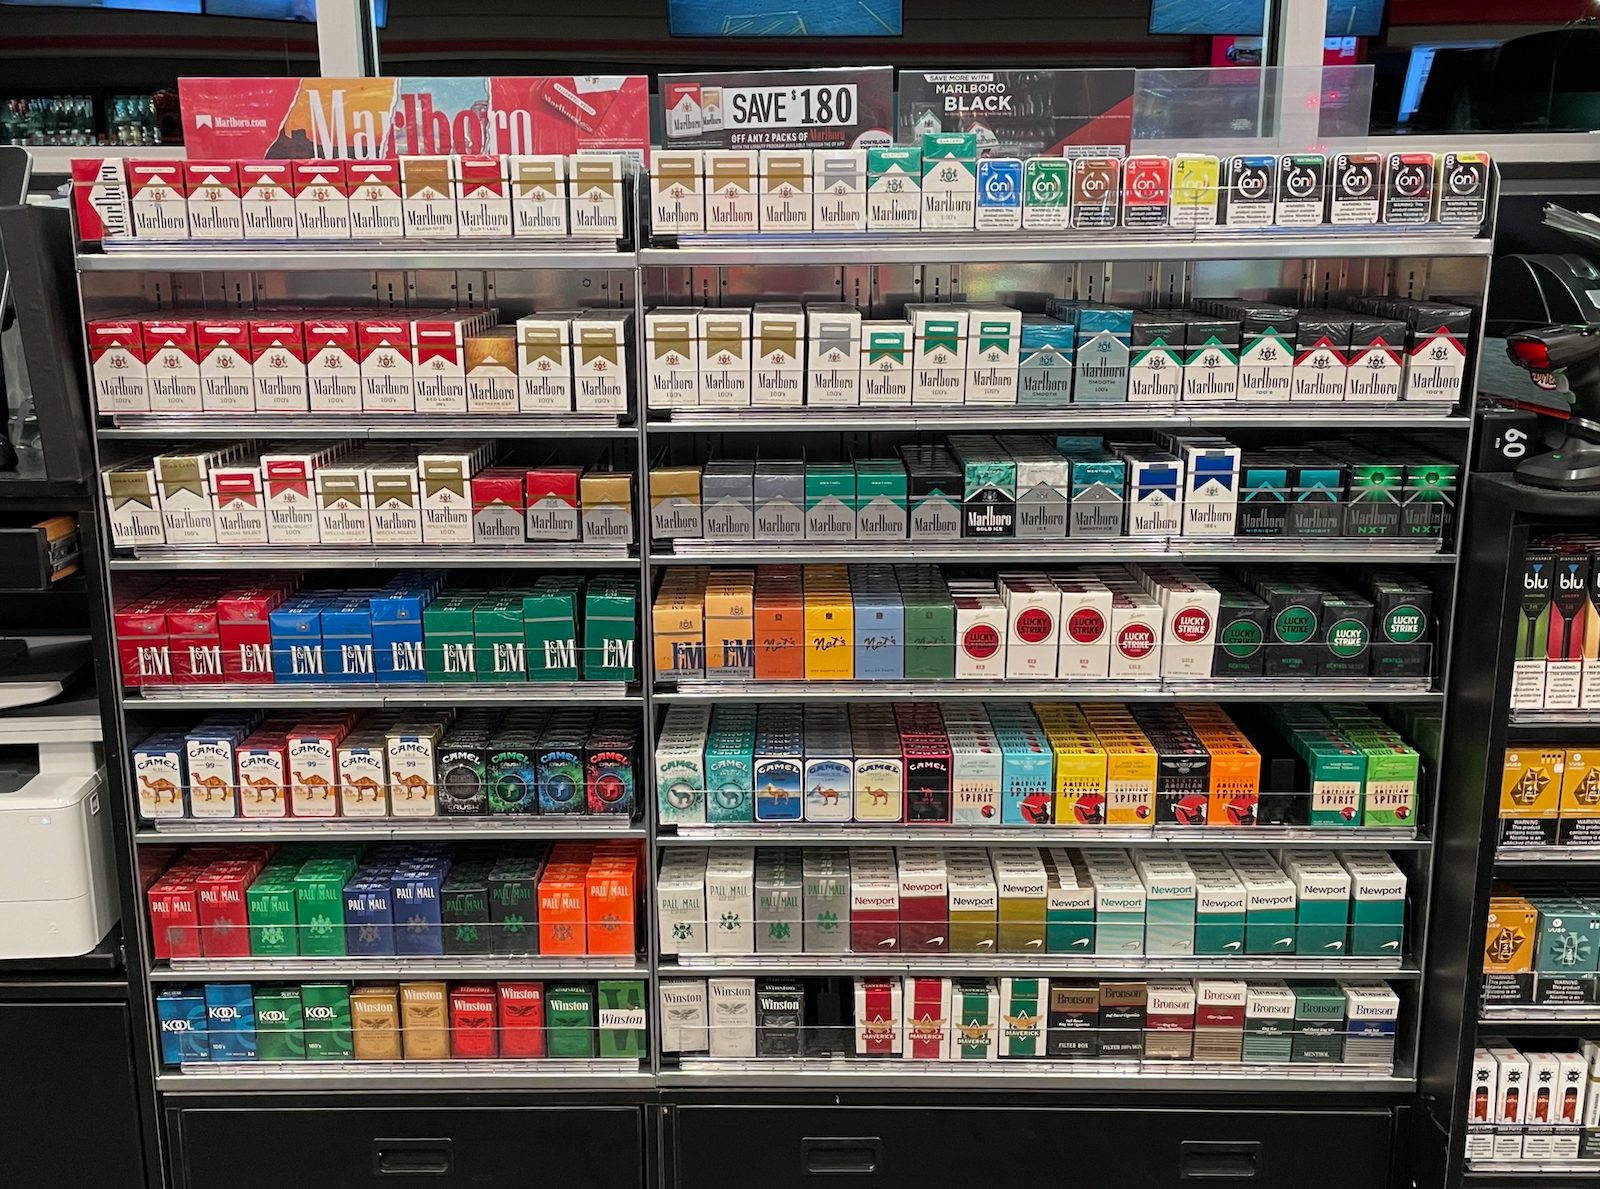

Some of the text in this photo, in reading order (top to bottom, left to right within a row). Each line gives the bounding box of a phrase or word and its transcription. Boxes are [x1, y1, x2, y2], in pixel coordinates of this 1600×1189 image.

[930, 73, 990, 82] SAVE MORE WITH
[935, 83, 1005, 94] MARLBORO
[732, 92, 787, 124] SAVE
[945, 95, 1012, 112] BLACK
[214, 116, 267, 129] Marlboro.com
[306, 89, 532, 159] Marlboro
[732, 128, 846, 144] OFF ANY 2 PACKS OF Marlboro
[980, 162, 989, 172] 4
[1234, 158, 1242, 170] 8
[1282, 157, 1292, 168] 8
[94, 166, 125, 237] Marlboro
[462, 204, 508, 226] Marlboro
[658, 202, 699, 222] Marlboro
[766, 202, 807, 222] Marlboro
[872, 200, 918, 221] Marlboro
[138, 207, 184, 229] Marlboro
[246, 206, 293, 228] Marlboro
[353, 206, 400, 228] Marlboro
[814, 369, 854, 390] Marlboro
[920, 368, 960, 386] Marlboro
[973, 368, 1012, 386] Marlboro
[100, 376, 143, 396] Marlboro
[206, 376, 250, 396] Marlboro
[417, 376, 464, 398] Marlboro
[525, 376, 566, 396] Marlboro
[1132, 374, 1178, 395] Marlboro
[1350, 374, 1398, 394] Marlboro
[1502, 428, 1528, 458] 09
[166, 508, 212, 529] Marlboro
[271, 506, 313, 524] Marlboro
[426, 505, 468, 523] Marlboro
[1020, 506, 1064, 527] Marlboro
[1190, 503, 1232, 522] Marlboro
[114, 512, 160, 538] Marlboro
[530, 512, 573, 530] Marlboro
[655, 510, 698, 530] Marlboro
[860, 514, 903, 533] Marlboro
[1358, 526, 1388, 534] NXT
[1412, 526, 1440, 534] NXT
[1024, 618, 1046, 626] LUCKY
[1180, 618, 1206, 626] LUCKY
[1392, 615, 1419, 625] LUCKY
[1021, 625, 1047, 634] STRIKE
[1178, 624, 1206, 634] STRIKE
[1336, 628, 1362, 638] LUCKY
[1390, 624, 1418, 633] STRIKE
[1124, 632, 1149, 642] LUCKY
[1334, 636, 1361, 647] STRIKE
[1120, 640, 1150, 650] STRIKE
[240, 643, 273, 672] L&M
[392, 642, 424, 672] L&M
[493, 643, 526, 672] L&M
[602, 639, 634, 668] L&M
[722, 639, 754, 668] L&M
[137, 646, 171, 676] L&M
[290, 645, 324, 675] L&M
[290, 744, 331, 758] CAMEL
[390, 744, 431, 758] CAMEL
[240, 757, 281, 770] CAMEL
[442, 750, 481, 765] CAMEL
[590, 750, 628, 765] CAMEL
[137, 758, 178, 772] CAMEL
[306, 760, 316, 768] 99
[406, 760, 416, 768] 99
[660, 759, 698, 773] CAMEL
[758, 762, 800, 774] CAMEL
[910, 761, 947, 772] CAMEL
[1064, 780, 1100, 788] AMERICAN
[960, 794, 994, 802] SPIRIT
[1115, 794, 1148, 802] SPIRIT
[1320, 795, 1356, 804] SPIRIT
[1374, 794, 1408, 804] SPIRIT
[902, 882, 943, 892] Newport
[1152, 884, 1192, 895] Newport
[1304, 884, 1346, 896] Newport
[1360, 886, 1402, 896] Newport
[201, 890, 240, 902] PALL MALL
[854, 895, 895, 906] Newport
[954, 896, 994, 906] Newport
[153, 902, 192, 912] PALL MALL
[349, 899, 387, 911] PALL MALL
[542, 898, 580, 909] PALL MALL
[662, 898, 700, 909] PALL MALL
[1052, 898, 1090, 908] Newport
[664, 992, 702, 1003] Winston
[1057, 994, 1094, 1004] Bronson
[1204, 988, 1240, 1000] Bronson
[354, 1000, 394, 1012] Winston
[454, 1000, 492, 1011] Winston
[550, 1000, 589, 1011] Winston
[760, 998, 800, 1010] Winston
[1152, 998, 1189, 1009] Bronson
[1252, 1002, 1290, 1014] Bronson
[209, 1007, 241, 1018] KOOL
[304, 1006, 337, 1018] KOOL
[1356, 1004, 1394, 1016] Bronson
[601, 1012, 643, 1025] Winston
[162, 1020, 194, 1030] KOOL
[862, 1032, 895, 1040] MAVERICK
[958, 1037, 990, 1045] MAVERICK
